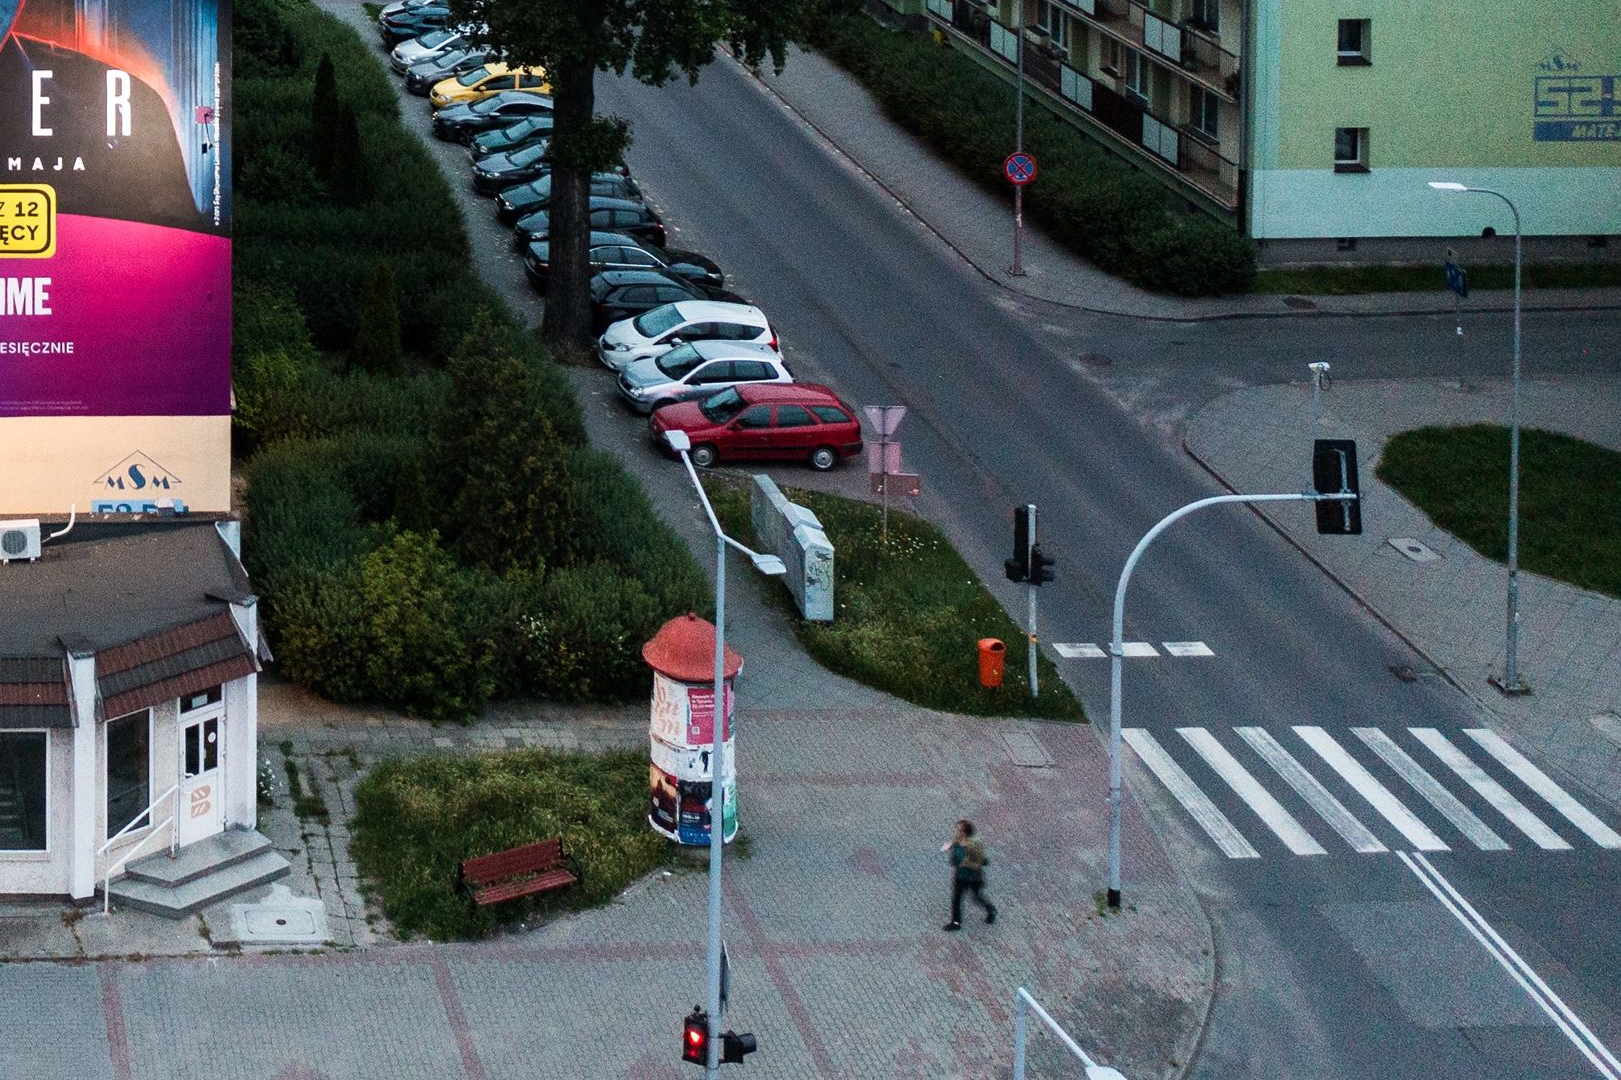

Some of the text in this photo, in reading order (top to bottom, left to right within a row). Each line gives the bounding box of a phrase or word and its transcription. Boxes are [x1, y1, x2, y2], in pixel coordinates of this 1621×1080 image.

[7, 156, 86, 172] MAJA
[14, 201, 39, 217] 12
[104, 463, 170, 490] MSM
